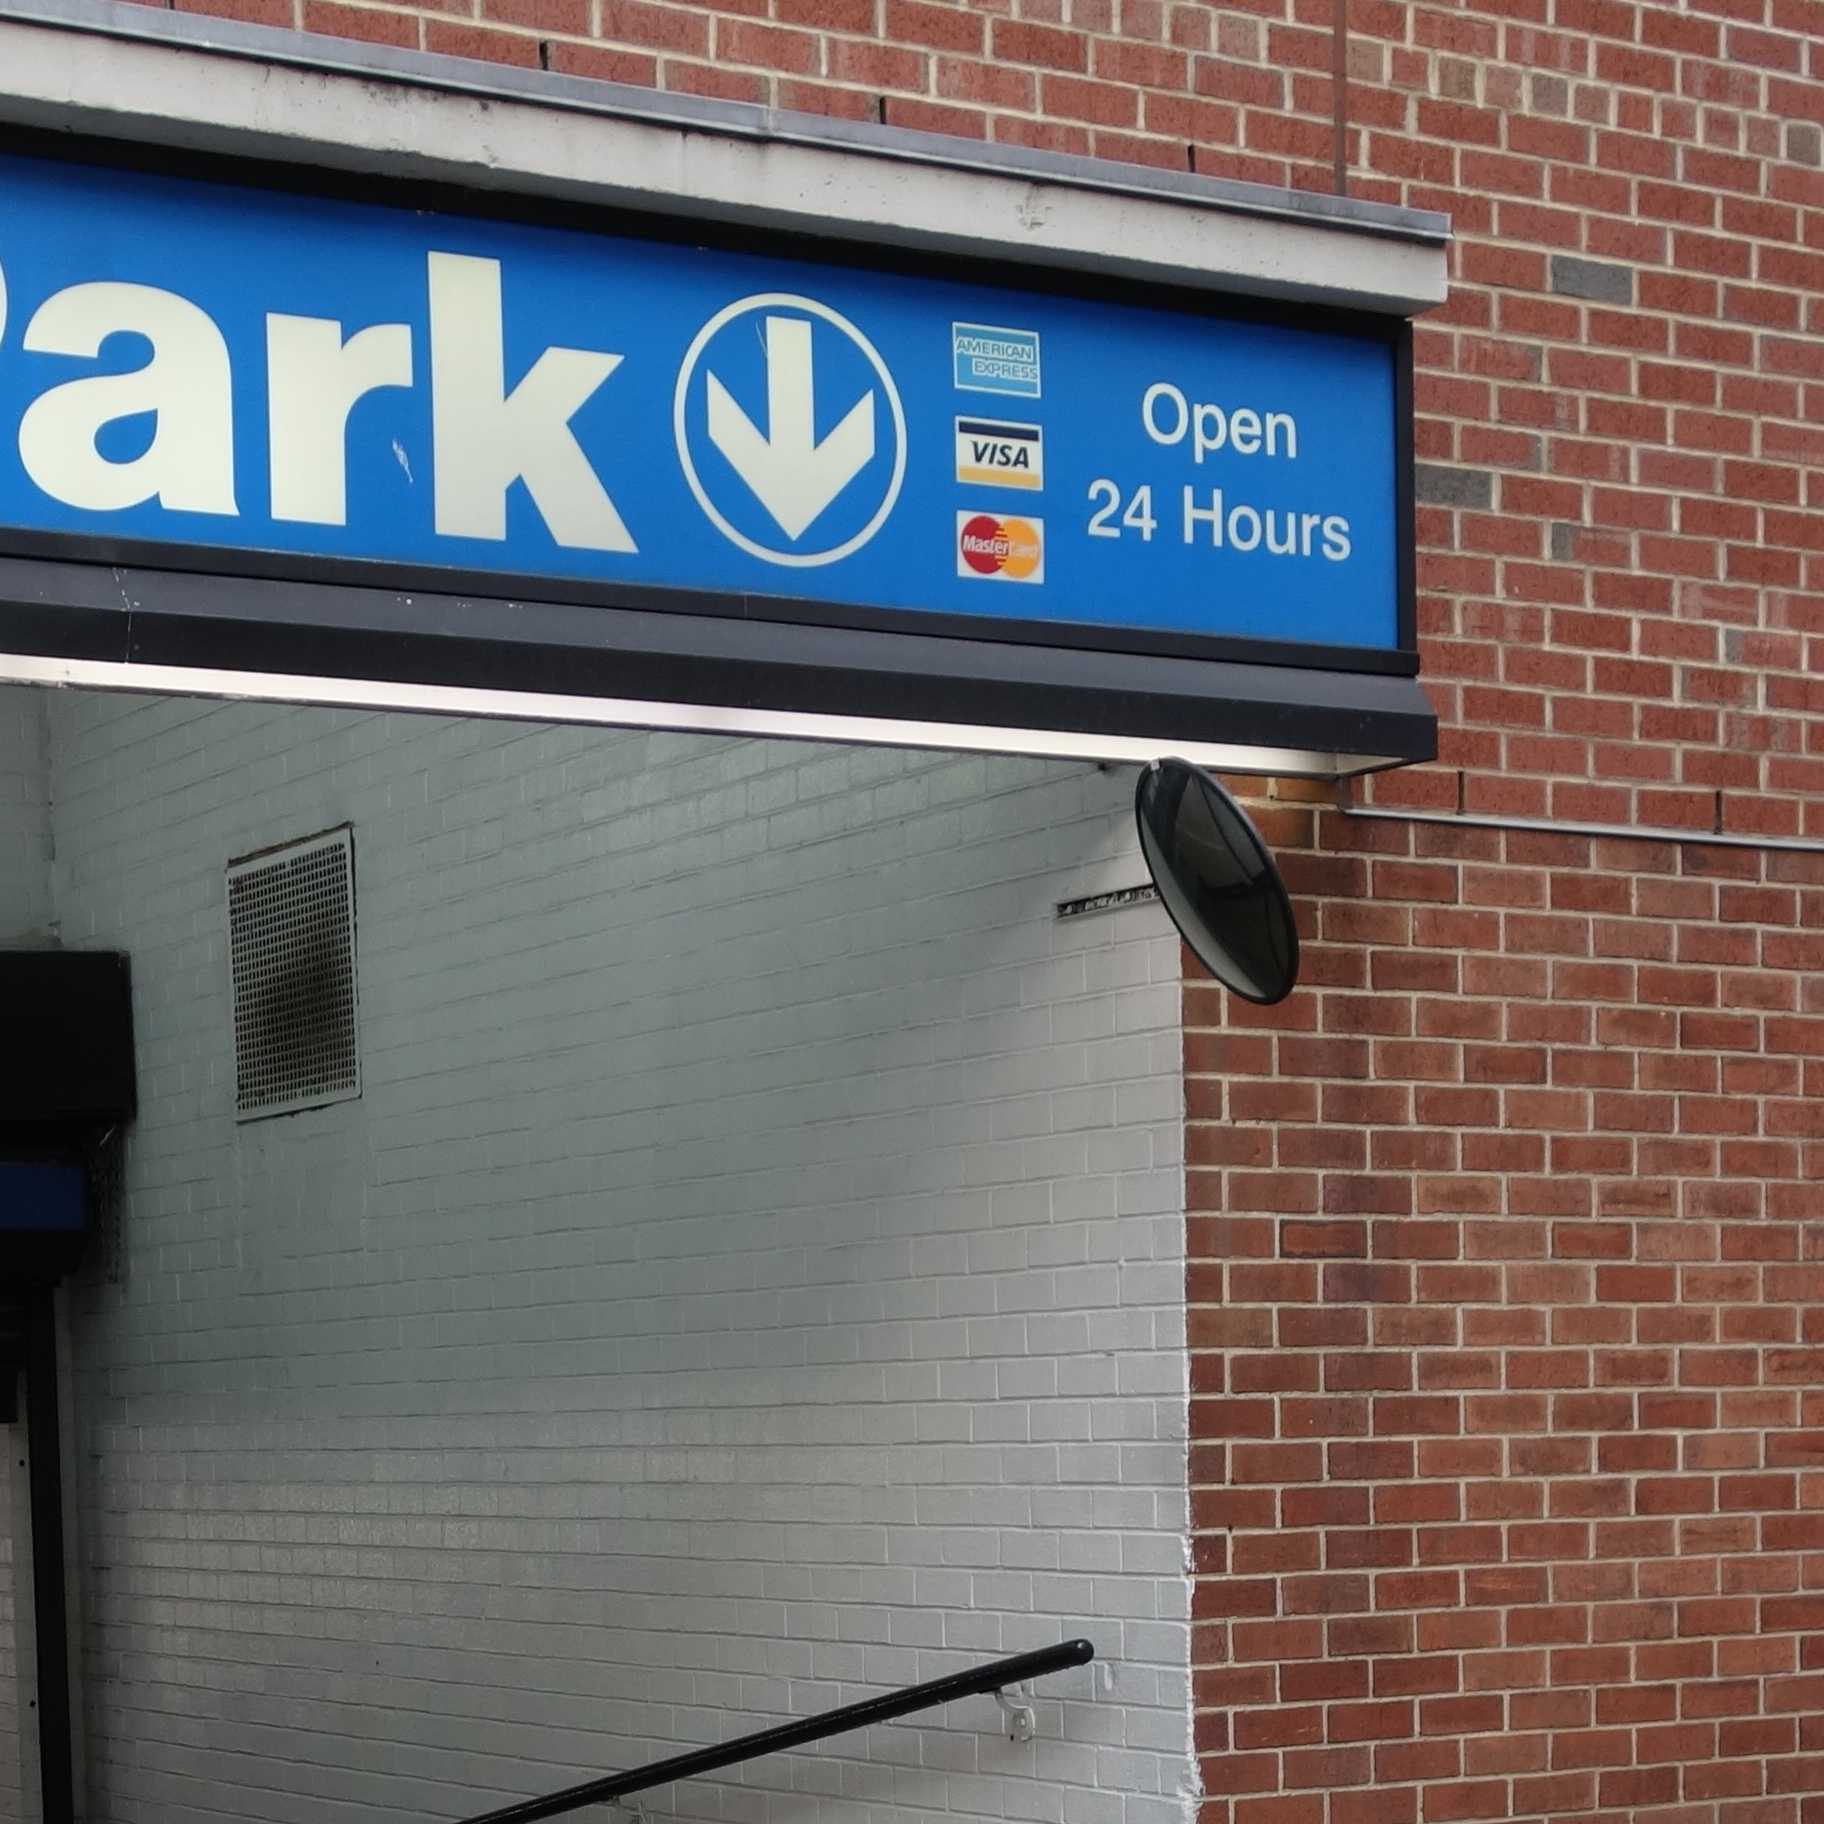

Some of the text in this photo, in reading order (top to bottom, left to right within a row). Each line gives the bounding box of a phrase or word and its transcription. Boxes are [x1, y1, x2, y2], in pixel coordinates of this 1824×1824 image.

[956, 338, 1033, 361] AMERICAN
[974, 360, 1038, 381] EXPRESS
[1142, 382, 1297, 464] Open
[971, 440, 1030, 469] VISA
[1087, 479, 1352, 562] 24 Hours
[963, 533, 1039, 558] MasterCard
